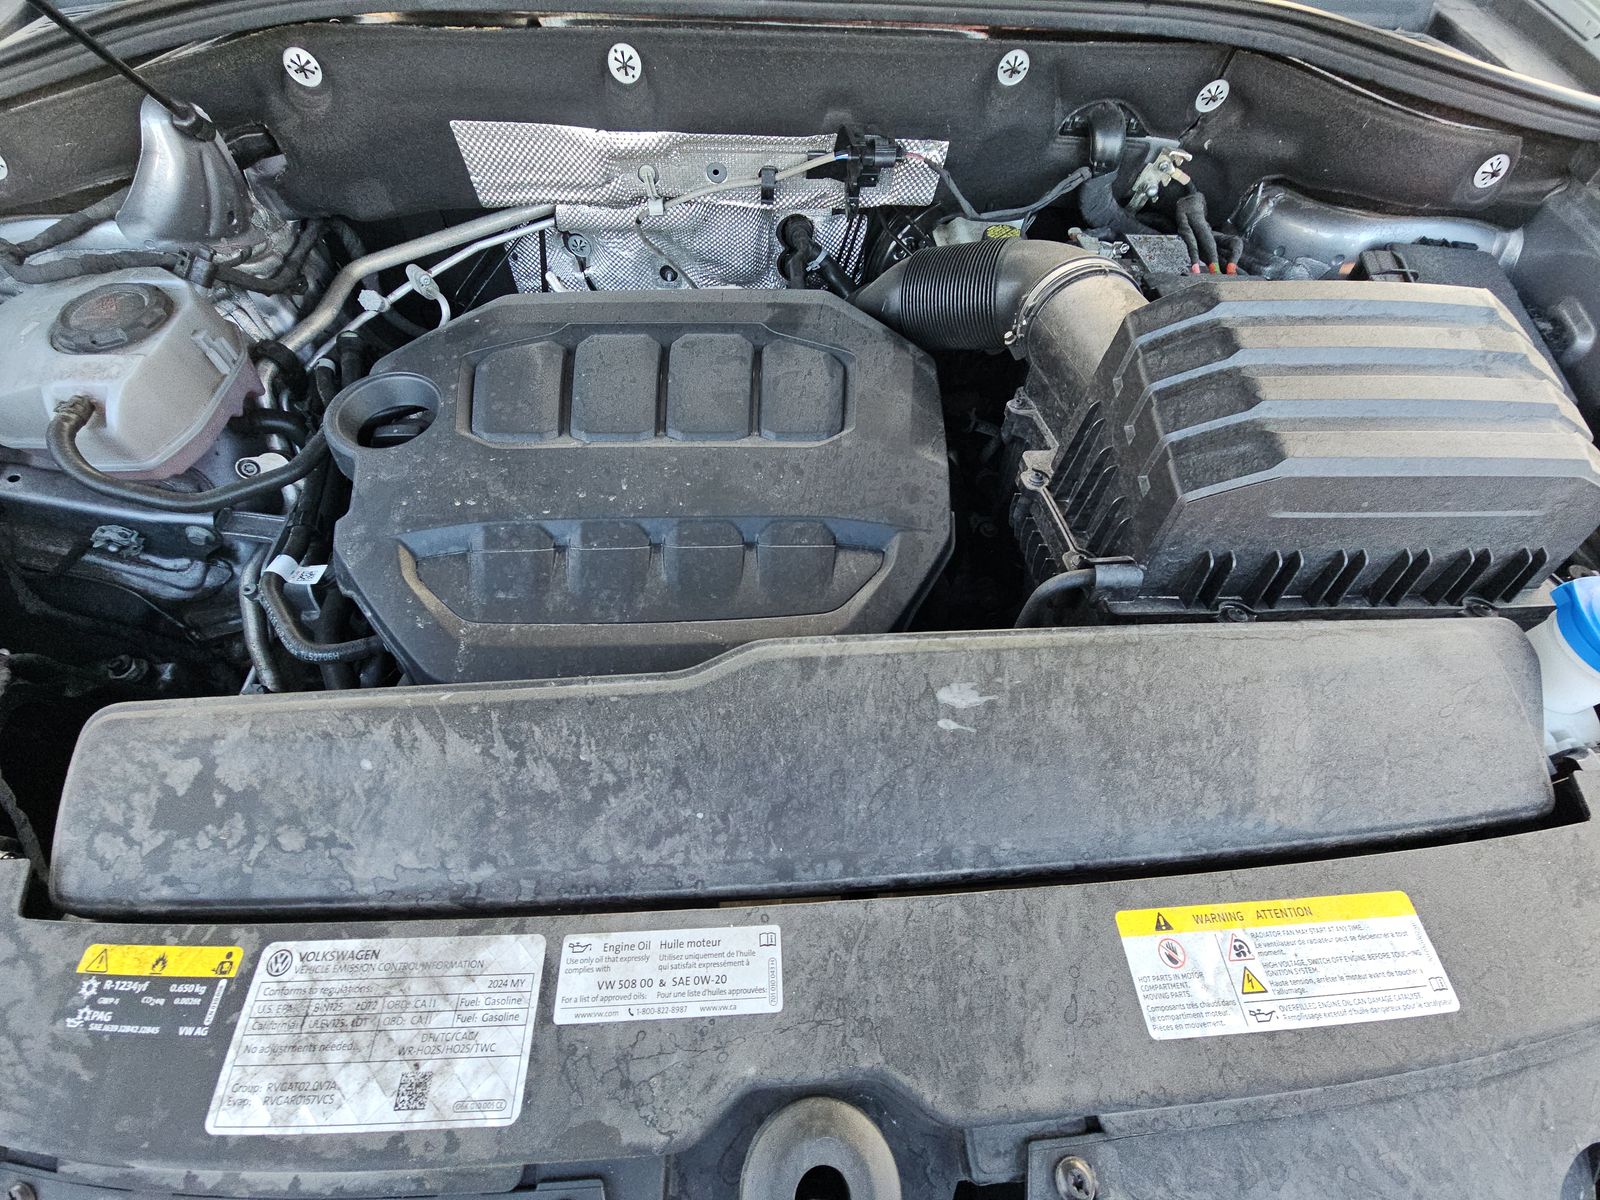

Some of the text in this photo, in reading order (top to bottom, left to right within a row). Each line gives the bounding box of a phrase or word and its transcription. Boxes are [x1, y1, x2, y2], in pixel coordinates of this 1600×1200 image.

[1192, 906, 1313, 925] WARNING ATTENTION
[603, 938, 722, 955] Engine Oil Huile moteur
[299, 949, 381, 962] VOLKSWAGEN
[566, 953, 651, 966] Use only oil that expressly
[658, 953, 684, 962] Utilisez
[685, 951, 726, 961] uniquement
[726, 949, 735, 958] de
[295, 964, 330, 975] VEHICLE
[332, 963, 375, 974] EMISSION
[378, 962, 420, 973] CONTROL
[565, 964, 611, 976] complies with
[658, 962, 670, 971] qui
[671, 960, 697, 970] satisfait
[698, 959, 745, 971] expressément
[487, 979, 526, 989] 2024 MY
[597, 974, 728, 991] VW 508 00 & SAE 0W-20
[1138, 975, 1151, 983] HOT
[1152, 973, 1173, 982] PARTS
[103, 980, 207, 995] R-1234yf 0.650 kg
[263, 986, 307, 997] Conforms
[308, 986, 318, 996] to
[657, 990, 672, 999] Pour
[673, 990, 686, 998] une
[687, 988, 701, 998] liste
[728, 985, 768, 996] approuvées:
[413, 999, 427, 1009] CA
[459, 997, 481, 1008] Fuel:
[484, 995, 523, 1006] Gasoline
[561, 995, 573, 1004] For
[580, 994, 590, 1003] list
[591, 994, 600, 1002] of
[600, 992, 632, 1004] approved
[633, 990, 648, 1000] oils:
[1143, 992, 1170, 1001] MOVING
[90, 1010, 113, 1022] PAG
[455, 1013, 478, 1023] Fuel:
[481, 1011, 520, 1022] Gasoline
[574, 1010, 620, 1019] www.vw.com
[700, 1003, 738, 1012] www.vw.ca
[178, 1026, 209, 1036] VW AG
[243, 1044, 257, 1054] No
[258, 1041, 318, 1057] adjustments
[231, 1082, 263, 1095] Group:
